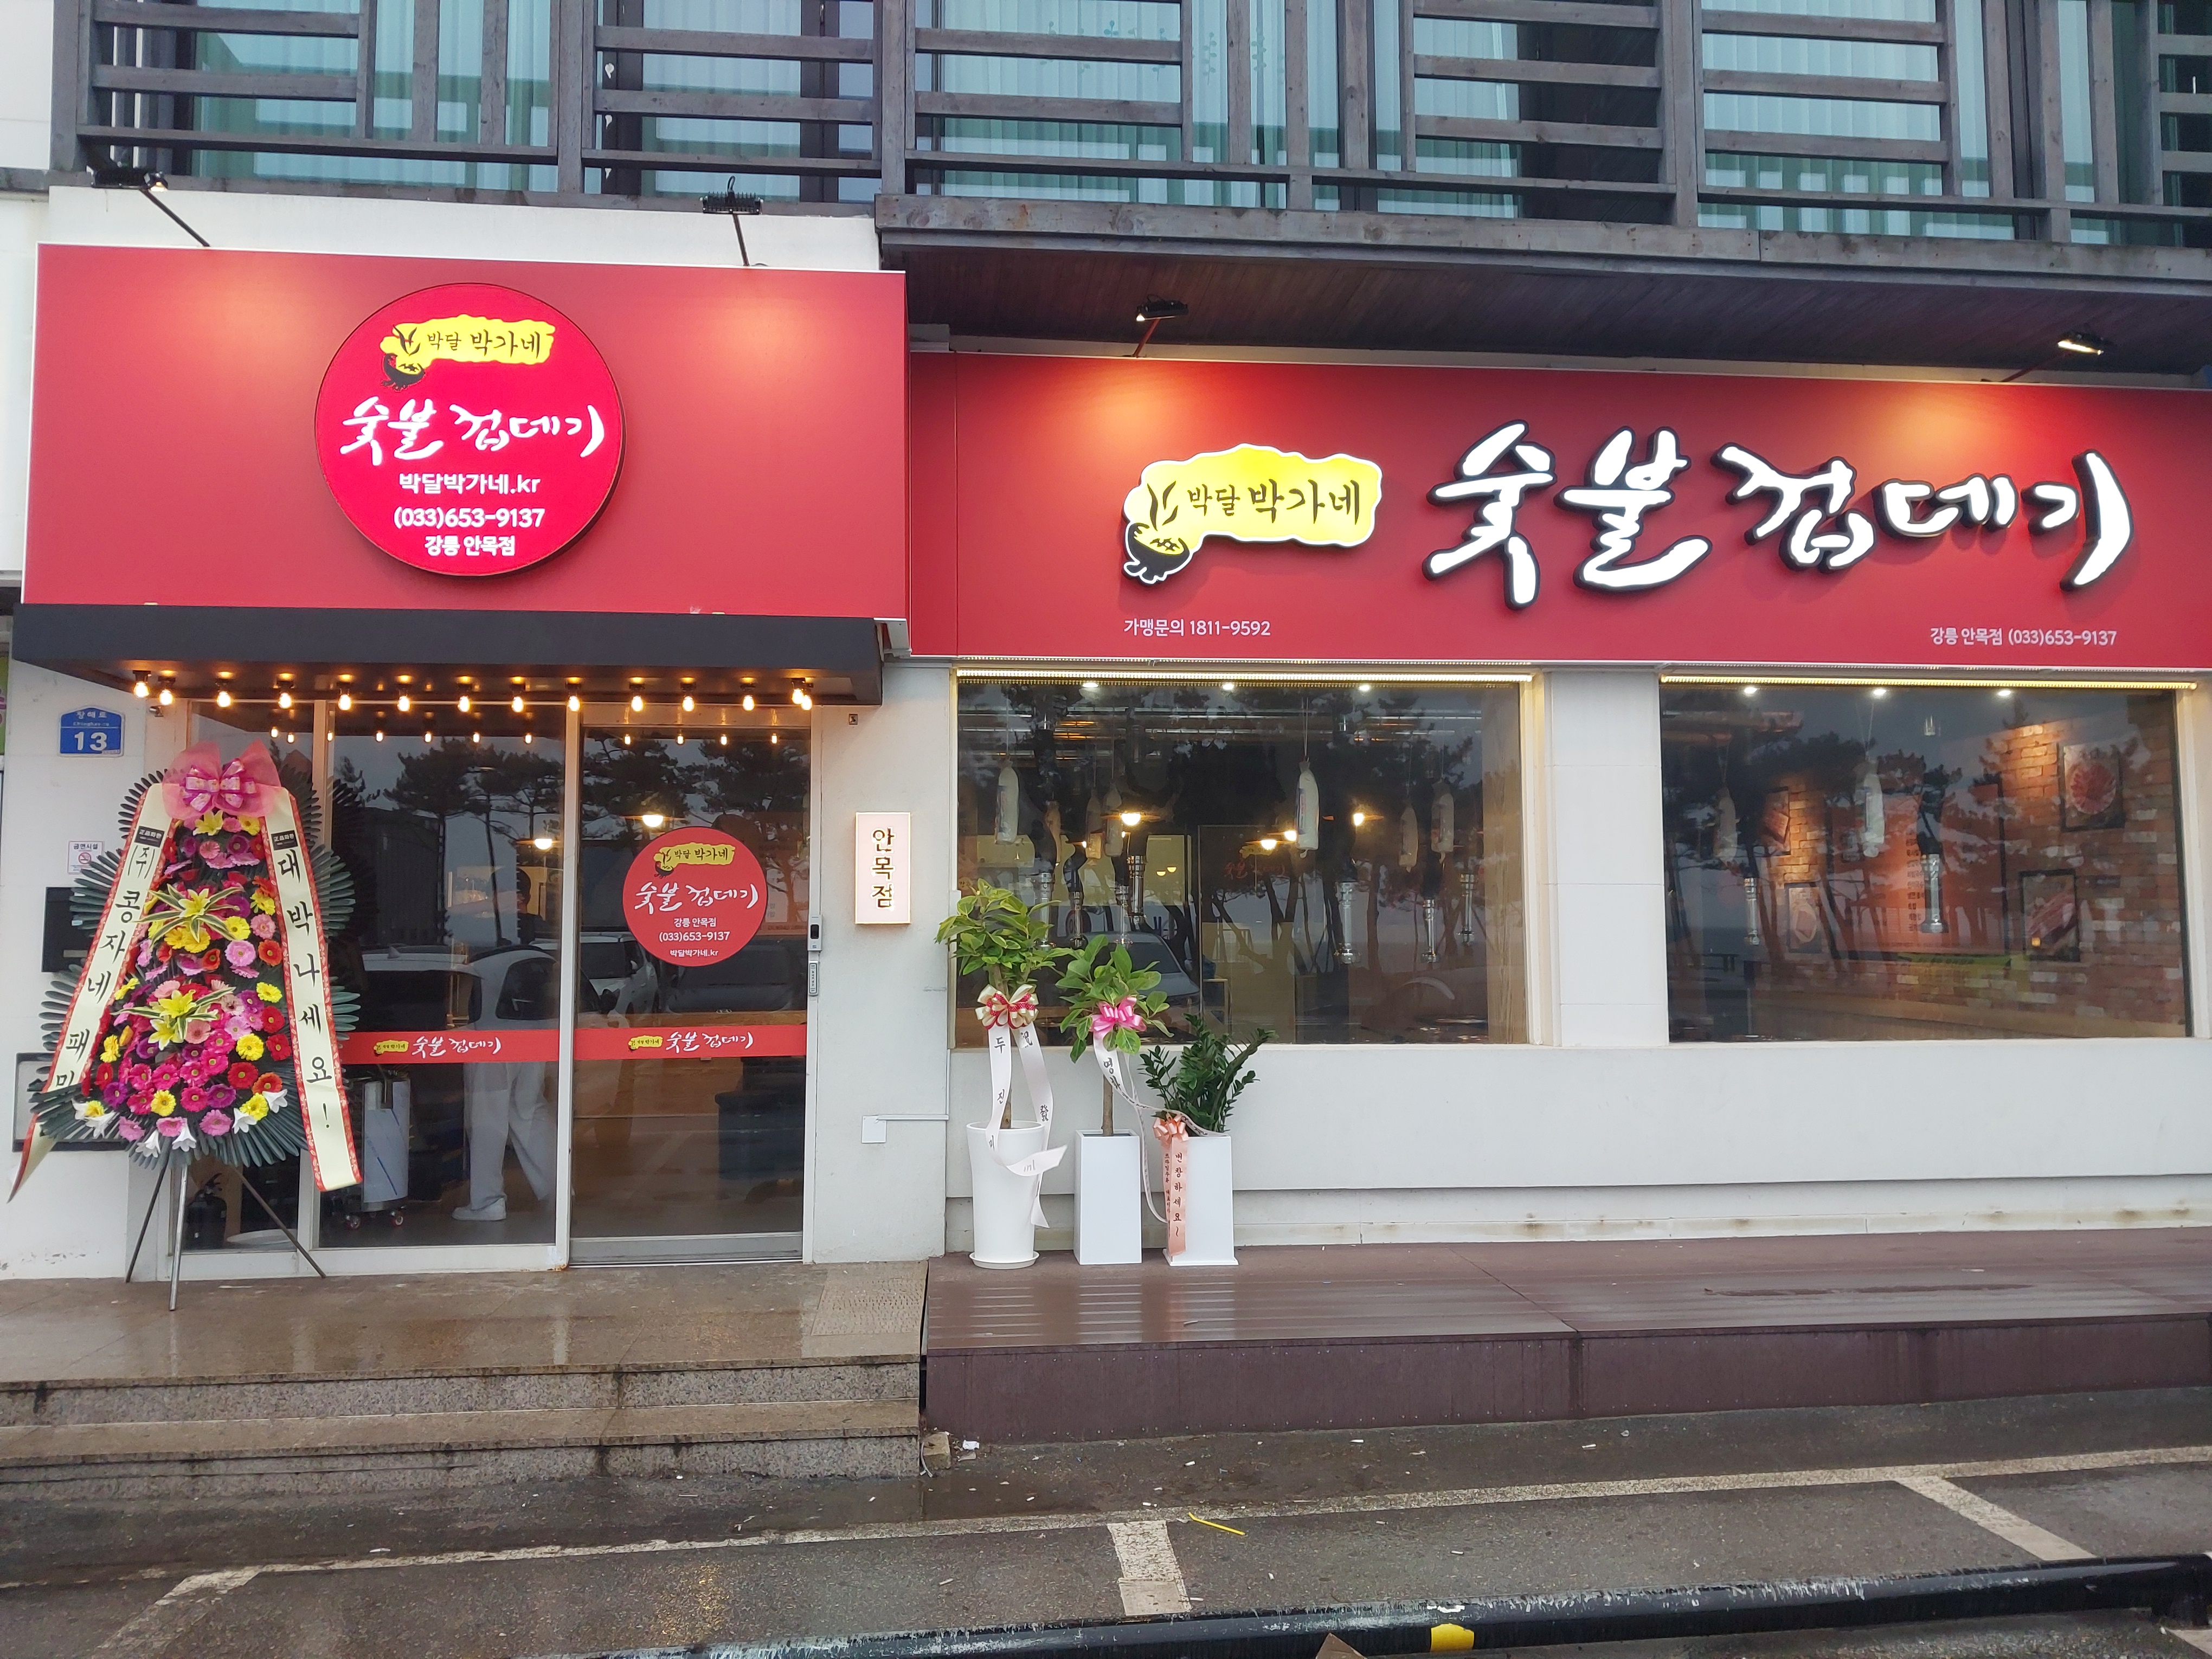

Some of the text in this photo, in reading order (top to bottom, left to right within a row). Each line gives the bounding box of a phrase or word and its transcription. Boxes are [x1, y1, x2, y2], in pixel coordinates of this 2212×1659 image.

[427, 330, 541, 358] 박달 박가네
[339, 396, 605, 466] 숯불 껍데기
[398, 473, 541, 494] 박달박가네.kr
[1187, 479, 1360, 526] 박달 박가네
[393, 507, 545, 530] (033)653-9137
[1424, 421, 2132, 607] 숯불 껍데기
[424, 535, 516, 556] 강릉 안목점
[1123, 619, 1271, 637] 가맹문의 1811-9592
[1930, 627, 2118, 646] 강릉 안목점 (033)653-9137
[74, 731, 107, 751] 13
[674, 847, 728, 860] 박달 박가네
[871, 827, 895, 909] 안목점
[634, 882, 759, 915] 숯불 껍데기
[673, 917, 717, 928] 강릉 안목점
[658, 931, 730, 942] (033)653-9137
[670, 949, 719, 958] 박달박가네.kr
[411, 1036, 447, 1059] 숯불
[448, 1037, 502, 1055] 껍데기
[665, 1031, 700, 1054] 숯불
[702, 1032, 754, 1050] 껍데기
